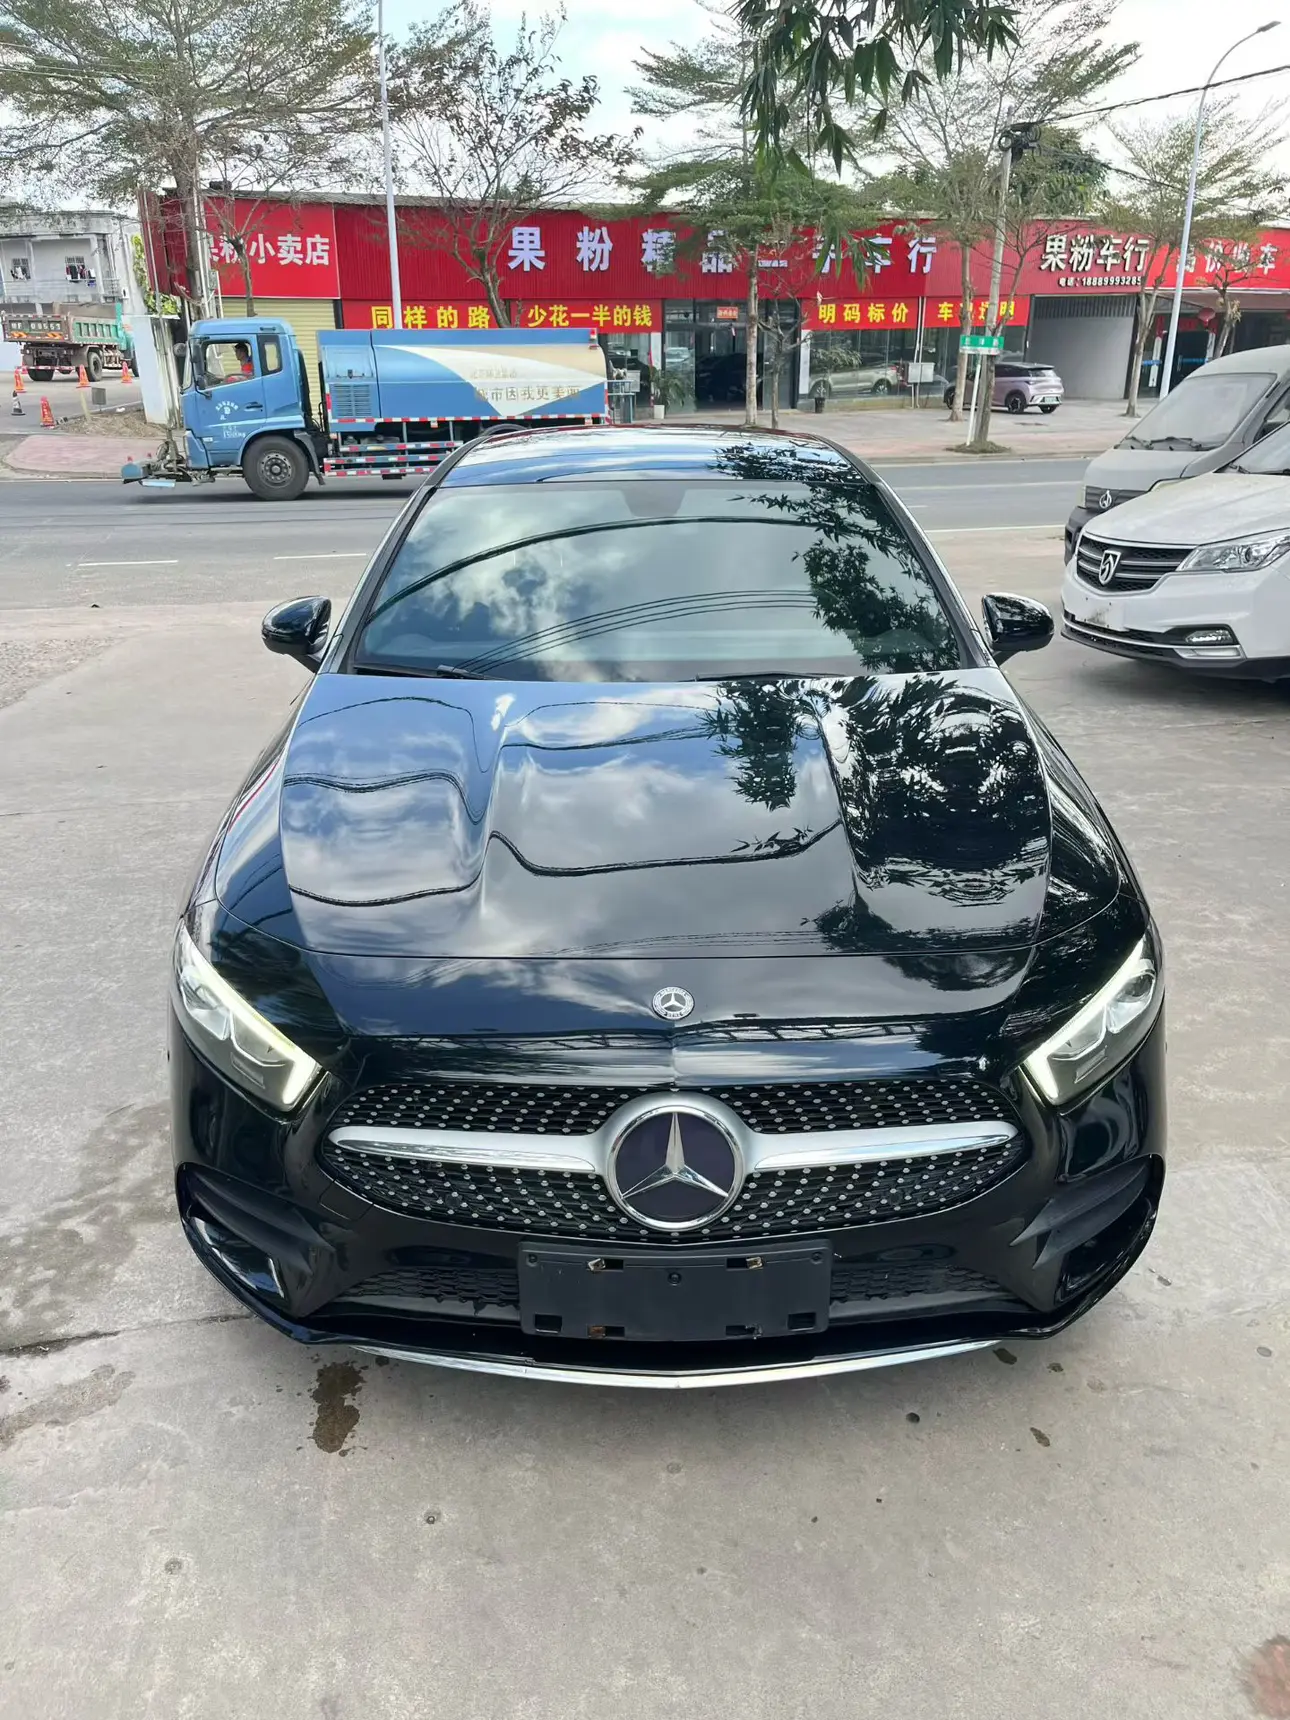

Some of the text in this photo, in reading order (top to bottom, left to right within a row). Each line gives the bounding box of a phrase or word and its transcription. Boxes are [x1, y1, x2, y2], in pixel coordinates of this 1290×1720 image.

[1039, 234, 1150, 272] 果粉车行
[371, 304, 653, 329] 同样的路 少花一半的钱
[817, 302, 909, 324] 明码标价
